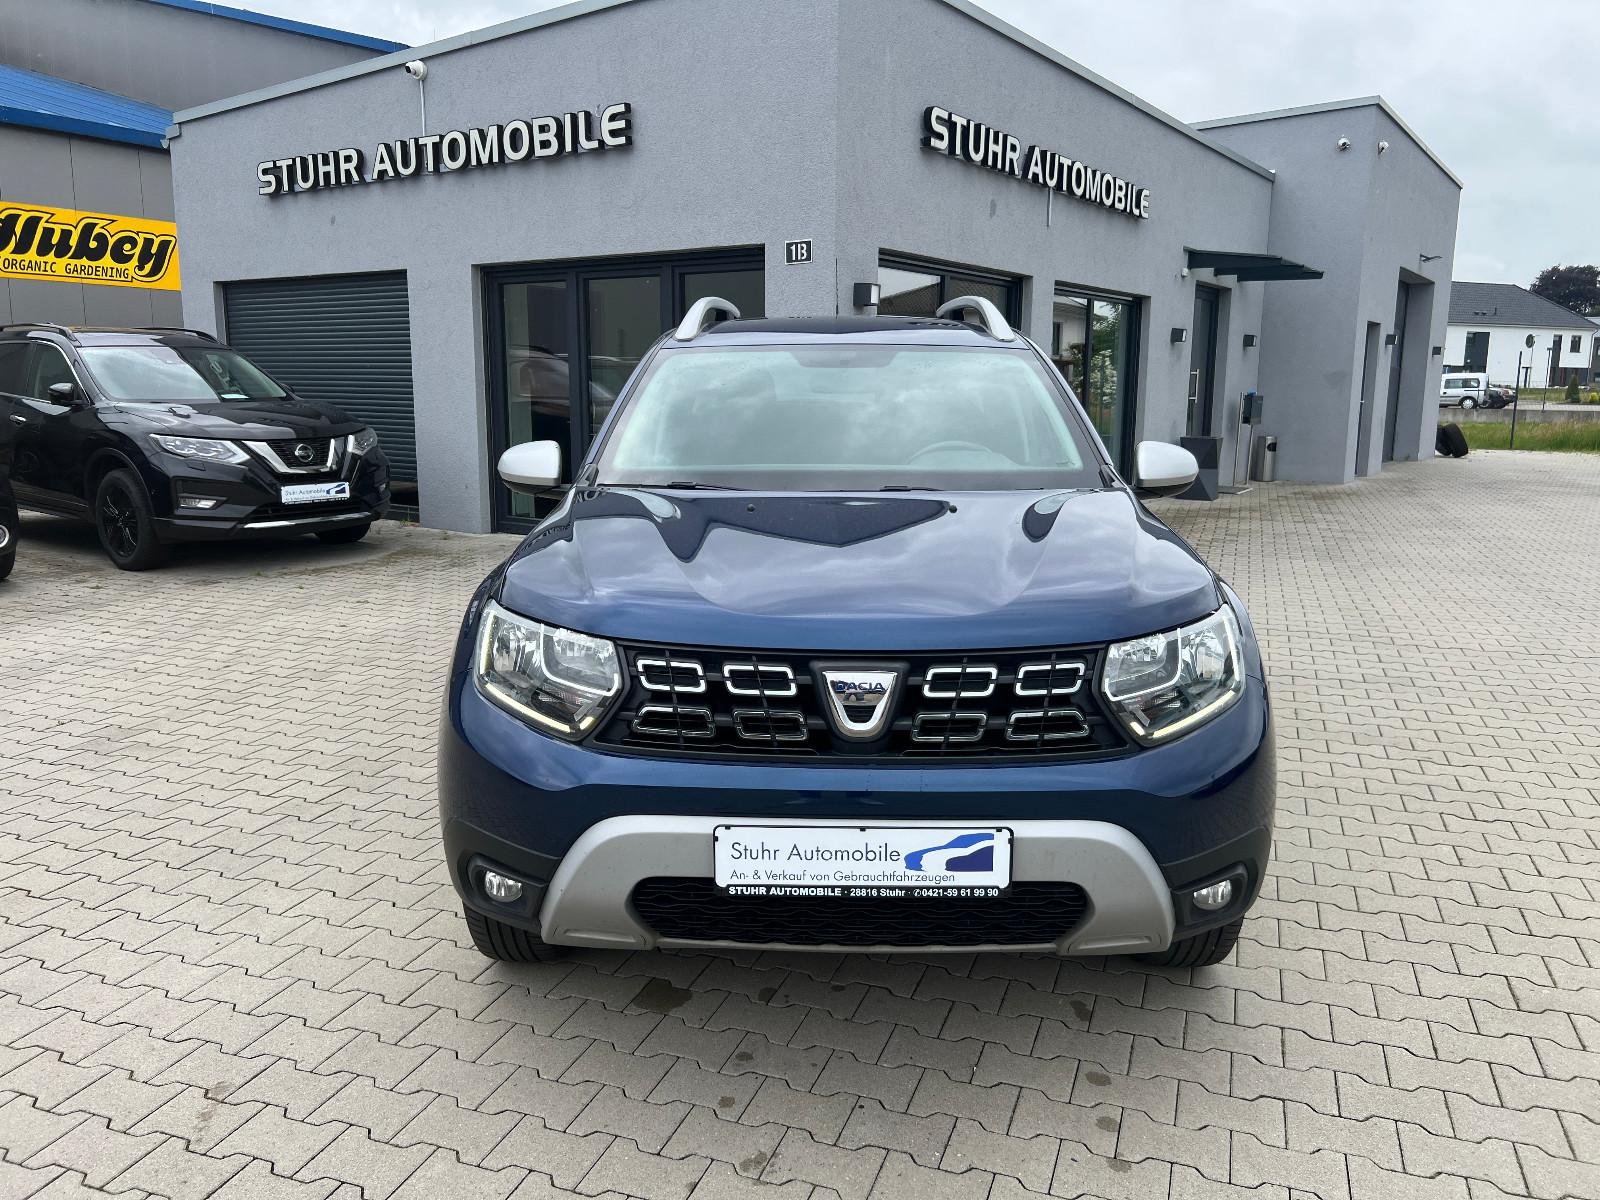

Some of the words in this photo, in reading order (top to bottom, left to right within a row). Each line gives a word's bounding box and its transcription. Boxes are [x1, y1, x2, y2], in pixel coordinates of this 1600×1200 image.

[256, 147, 363, 196] STUHR
[371, 102, 630, 181] AUTOMOBILE
[927, 106, 1021, 176] STUHR
[1026, 146, 1150, 219] AUTOMOBILE
[790, 243, 808, 261] 1B
[2, 257, 57, 273] ORGANIC
[64, 262, 130, 279] GARDENING
[835, 682, 886, 692] DACIA
[730, 841, 780, 860] Stuhr
[786, 842, 901, 862] Automobile
[730, 869, 749, 881] An-
[752, 869, 761, 881] &
[764, 869, 807, 882] Verkauf
[809, 873, 830, 882] von
[833, 870, 956, 885] Gebrauchtfahrzeugen
[728, 886, 767, 896] STUHR
[769, 887, 842, 897] AUTOMOBILE
[850, 887, 878, 897] 28816
[880, 887, 906, 897] Stuhr
[960, 888, 973, 898] 61
[974, 888, 985, 898] 99
[987, 888, 999, 898] 90
